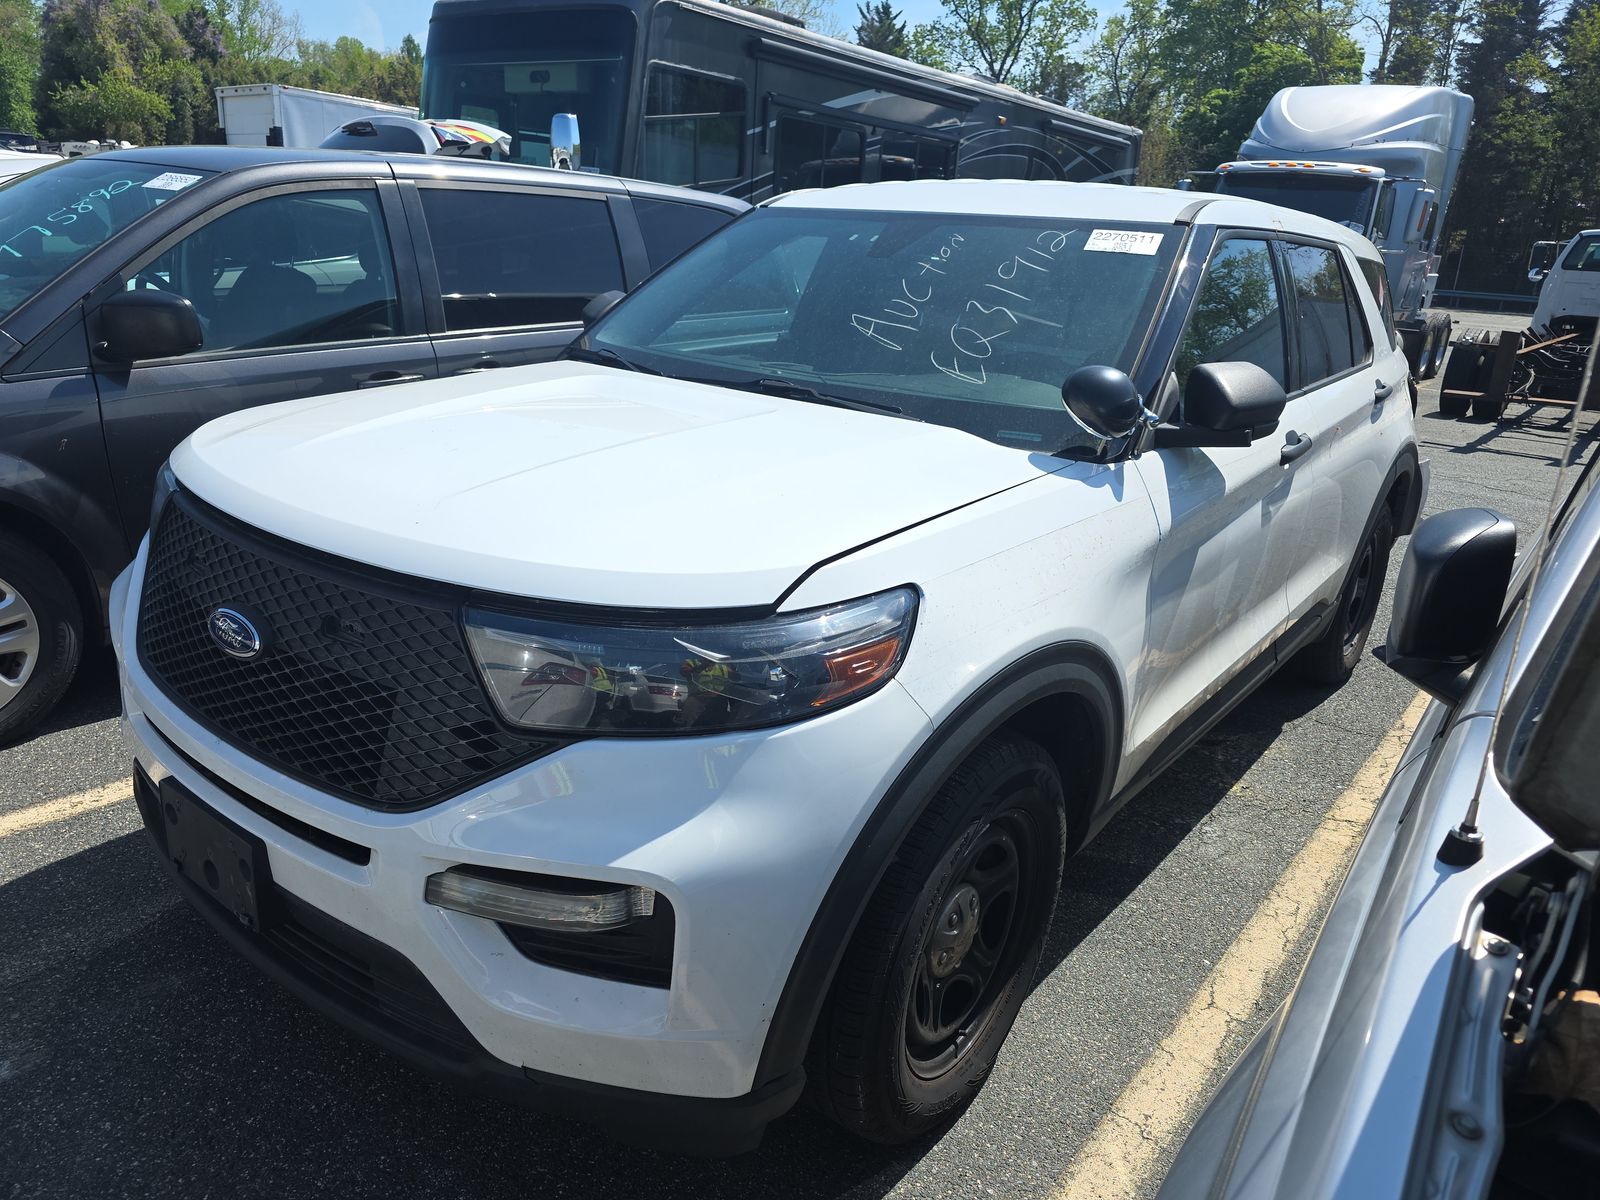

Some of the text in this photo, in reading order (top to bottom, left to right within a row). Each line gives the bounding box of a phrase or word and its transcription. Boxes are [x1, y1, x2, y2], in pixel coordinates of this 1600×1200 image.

[1093, 231, 1155, 244] 2270511
[931, 229, 1080, 385] EQ31912
[217, 616, 253, 647] Ford
